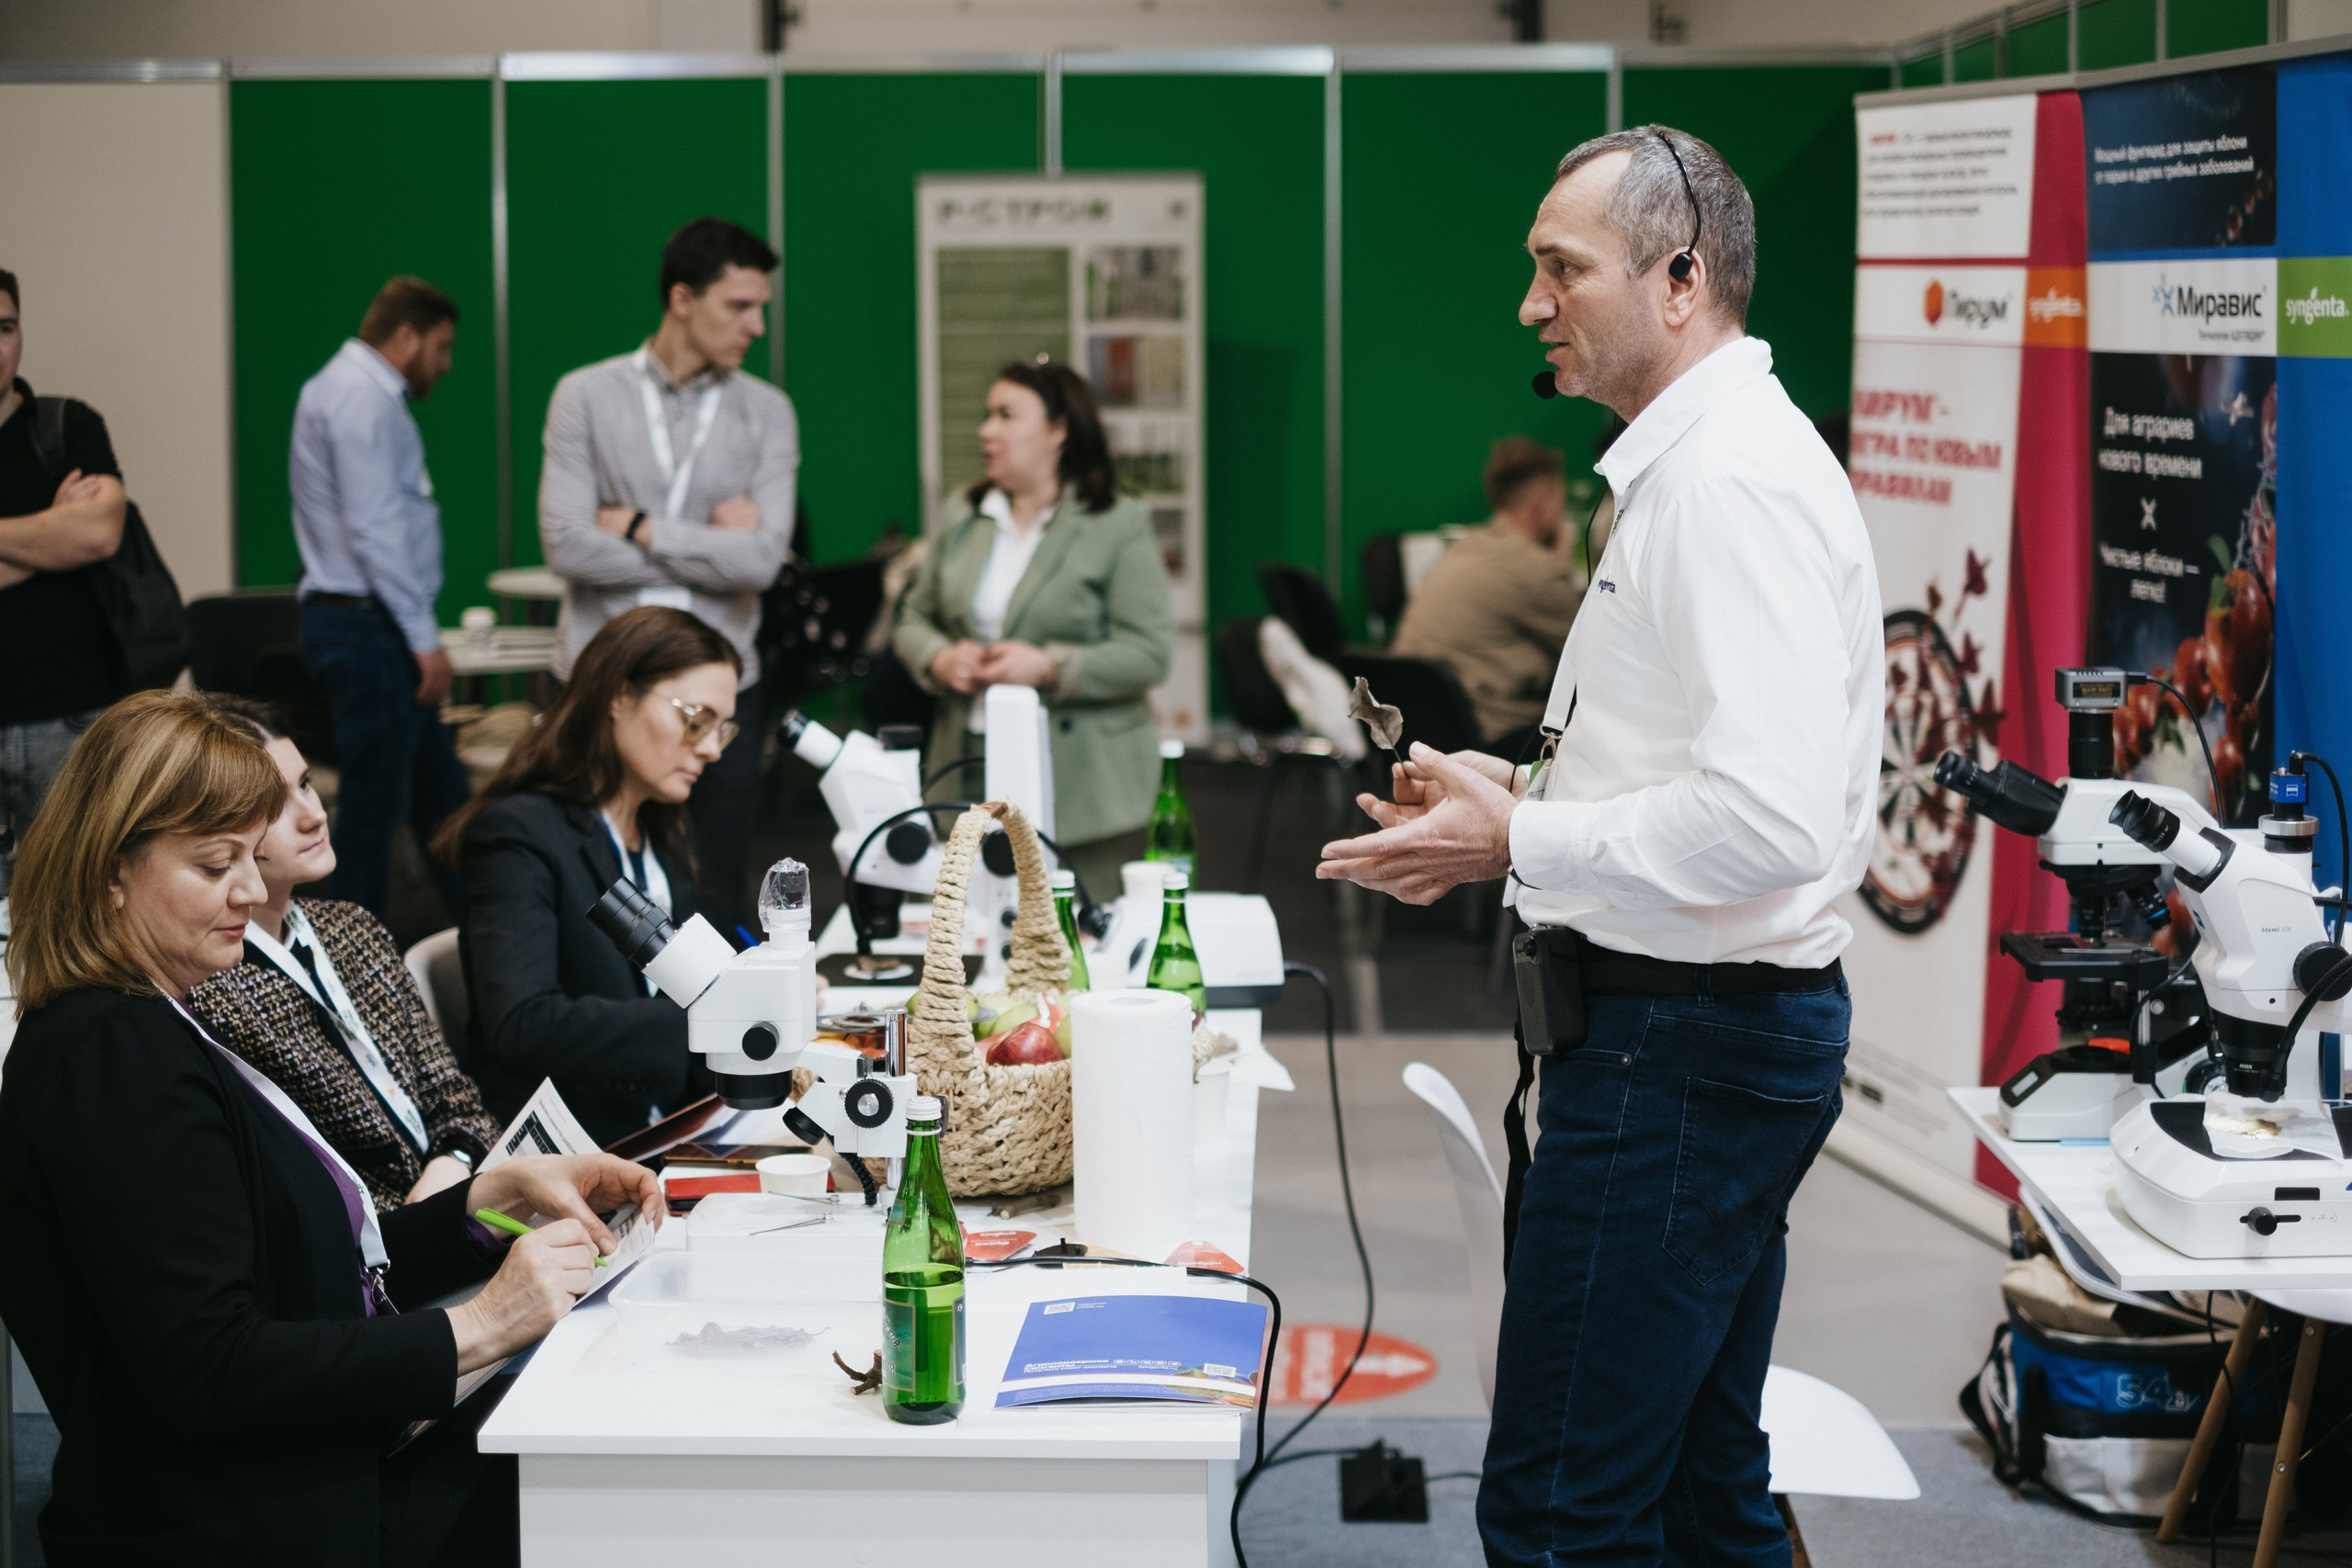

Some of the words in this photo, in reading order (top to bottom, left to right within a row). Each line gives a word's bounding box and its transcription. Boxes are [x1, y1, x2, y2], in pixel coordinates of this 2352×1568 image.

[2182, 139, 2215, 156] защиты
[2216, 133, 2247, 152] яблони
[2199, 155, 2254, 175] заболеваний
[2177, 286, 2263, 326] Миравис
[2285, 286, 2346, 325] syngenta
[2104, 406, 2130, 439] Для
[2132, 414, 2195, 444] аграриев
[2098, 449, 2142, 474] нового
[2143, 452, 2202, 480] времени
[2143, 548, 2184, 578] яблоки
